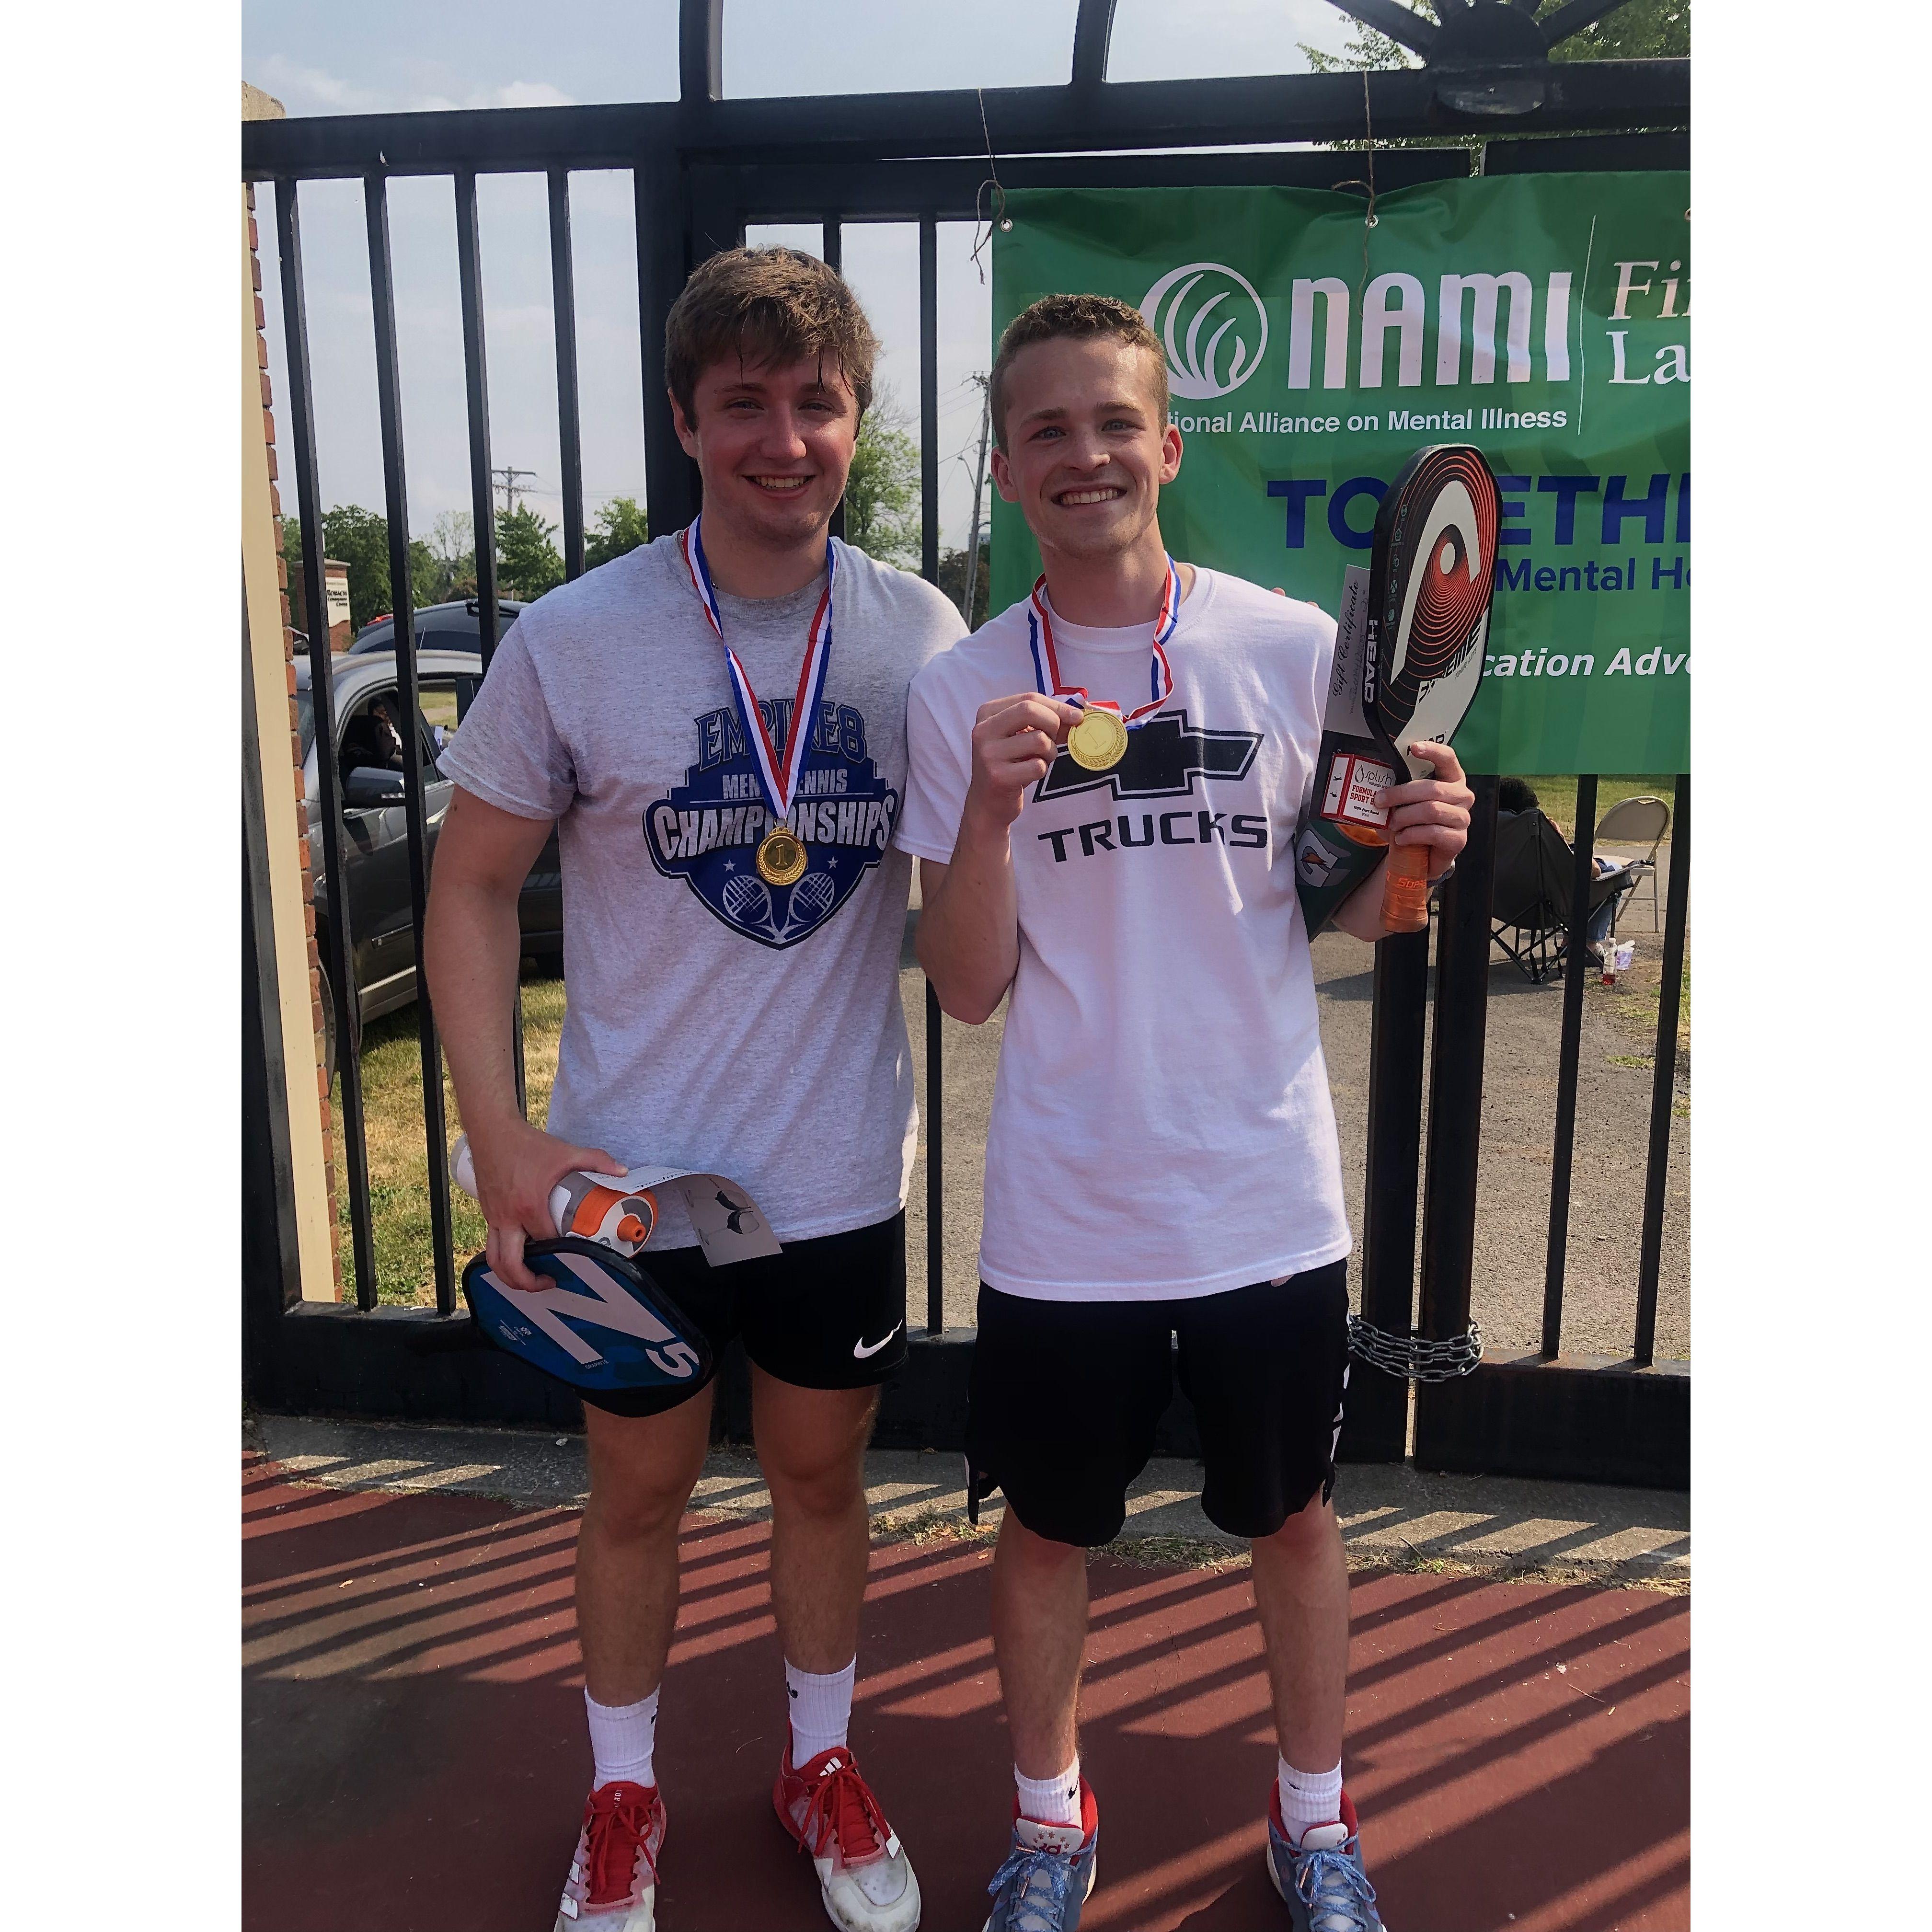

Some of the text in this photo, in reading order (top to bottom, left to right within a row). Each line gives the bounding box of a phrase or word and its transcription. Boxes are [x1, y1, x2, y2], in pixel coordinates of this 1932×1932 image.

[1608, 260, 1690, 320] Fi
[1288, 271, 1572, 390] NAMI
[1239, 412, 1340, 433] Alliance
[1347, 415, 1379, 432] on
[1388, 409, 1472, 430] Mental
[1482, 408, 1567, 429] Illness
[1267, 472, 1690, 549] TOETH
[1495, 556, 1690, 592] Mental H
[1333, 579, 1359, 696] Gift Certificate
[1365, 620, 1378, 703] HEAD
[1604, 646, 1690, 676] Adv
[1350, 792, 1369, 804] SPORT
[1037, 810, 1268, 862] TRUCKS
